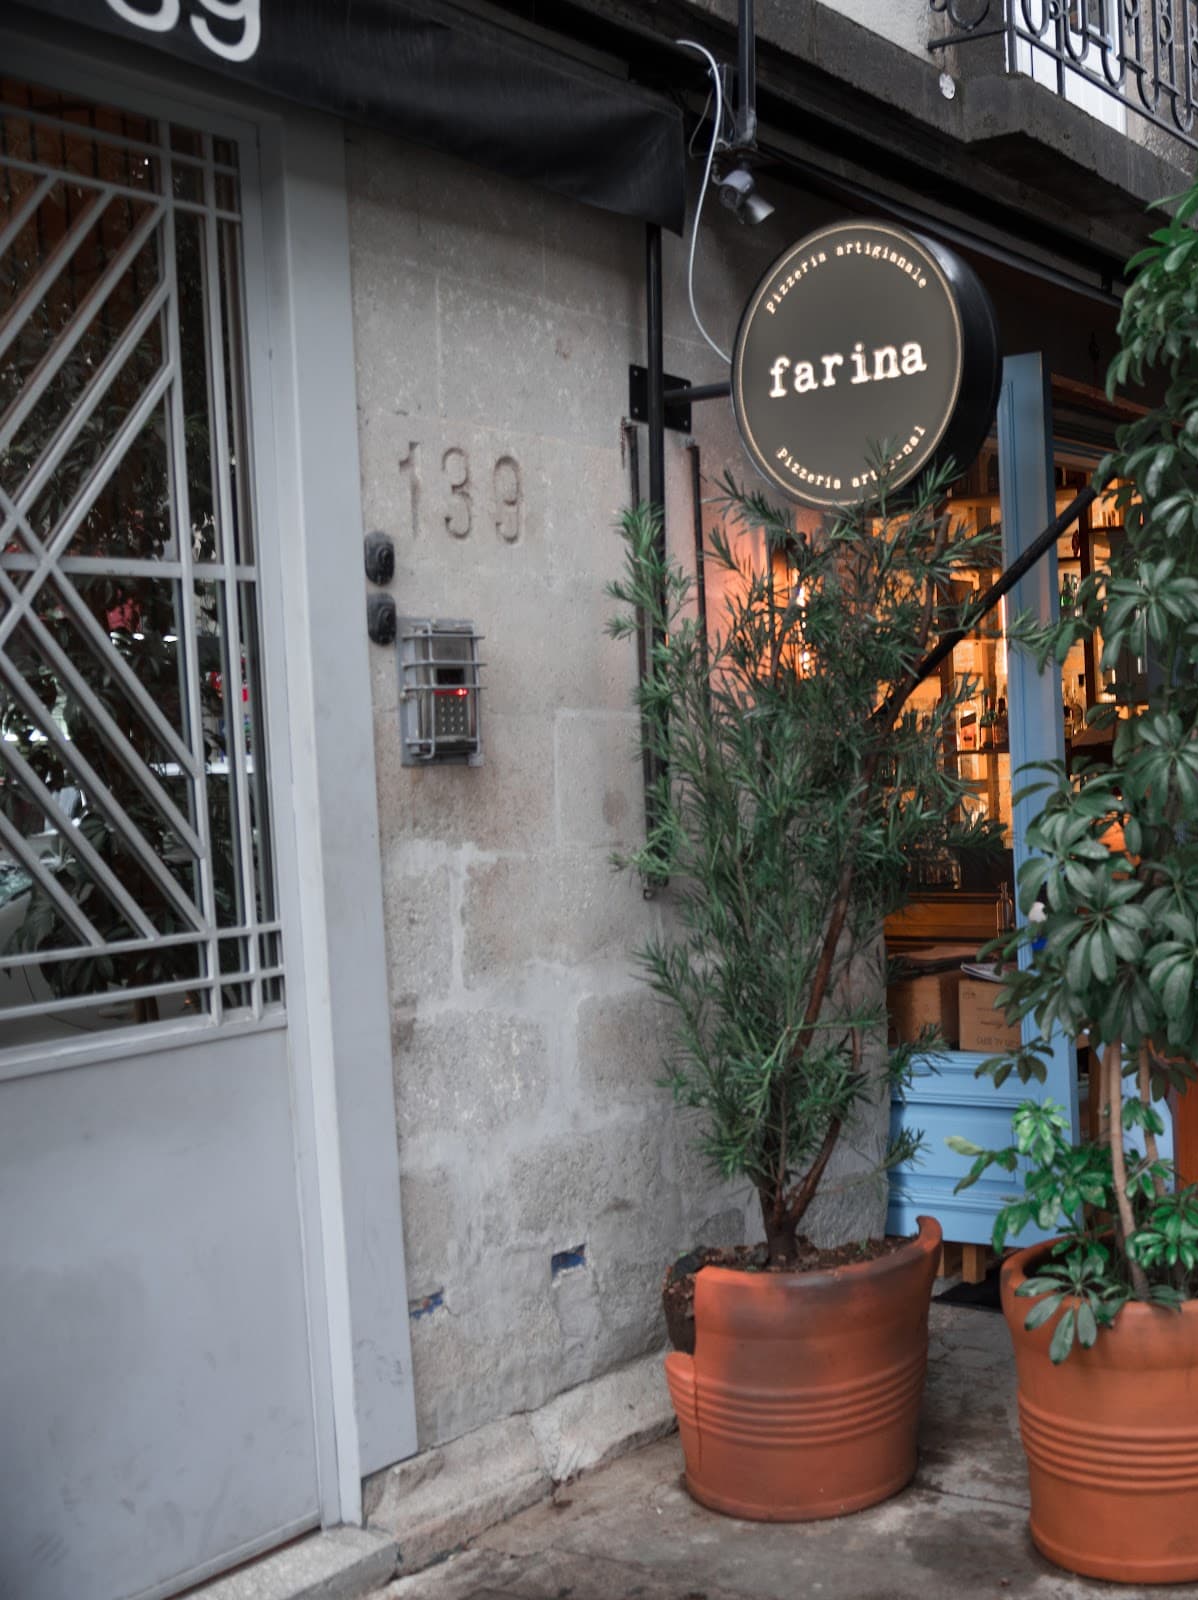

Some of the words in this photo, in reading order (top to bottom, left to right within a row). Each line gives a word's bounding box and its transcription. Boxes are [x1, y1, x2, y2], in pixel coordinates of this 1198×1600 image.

[766, 251, 827, 315] Pizzeria
[836, 241, 928, 288] artigianale
[769, 341, 928, 398] farina
[399, 441, 524, 545] 139
[776, 447, 842, 490] Pizzeria
